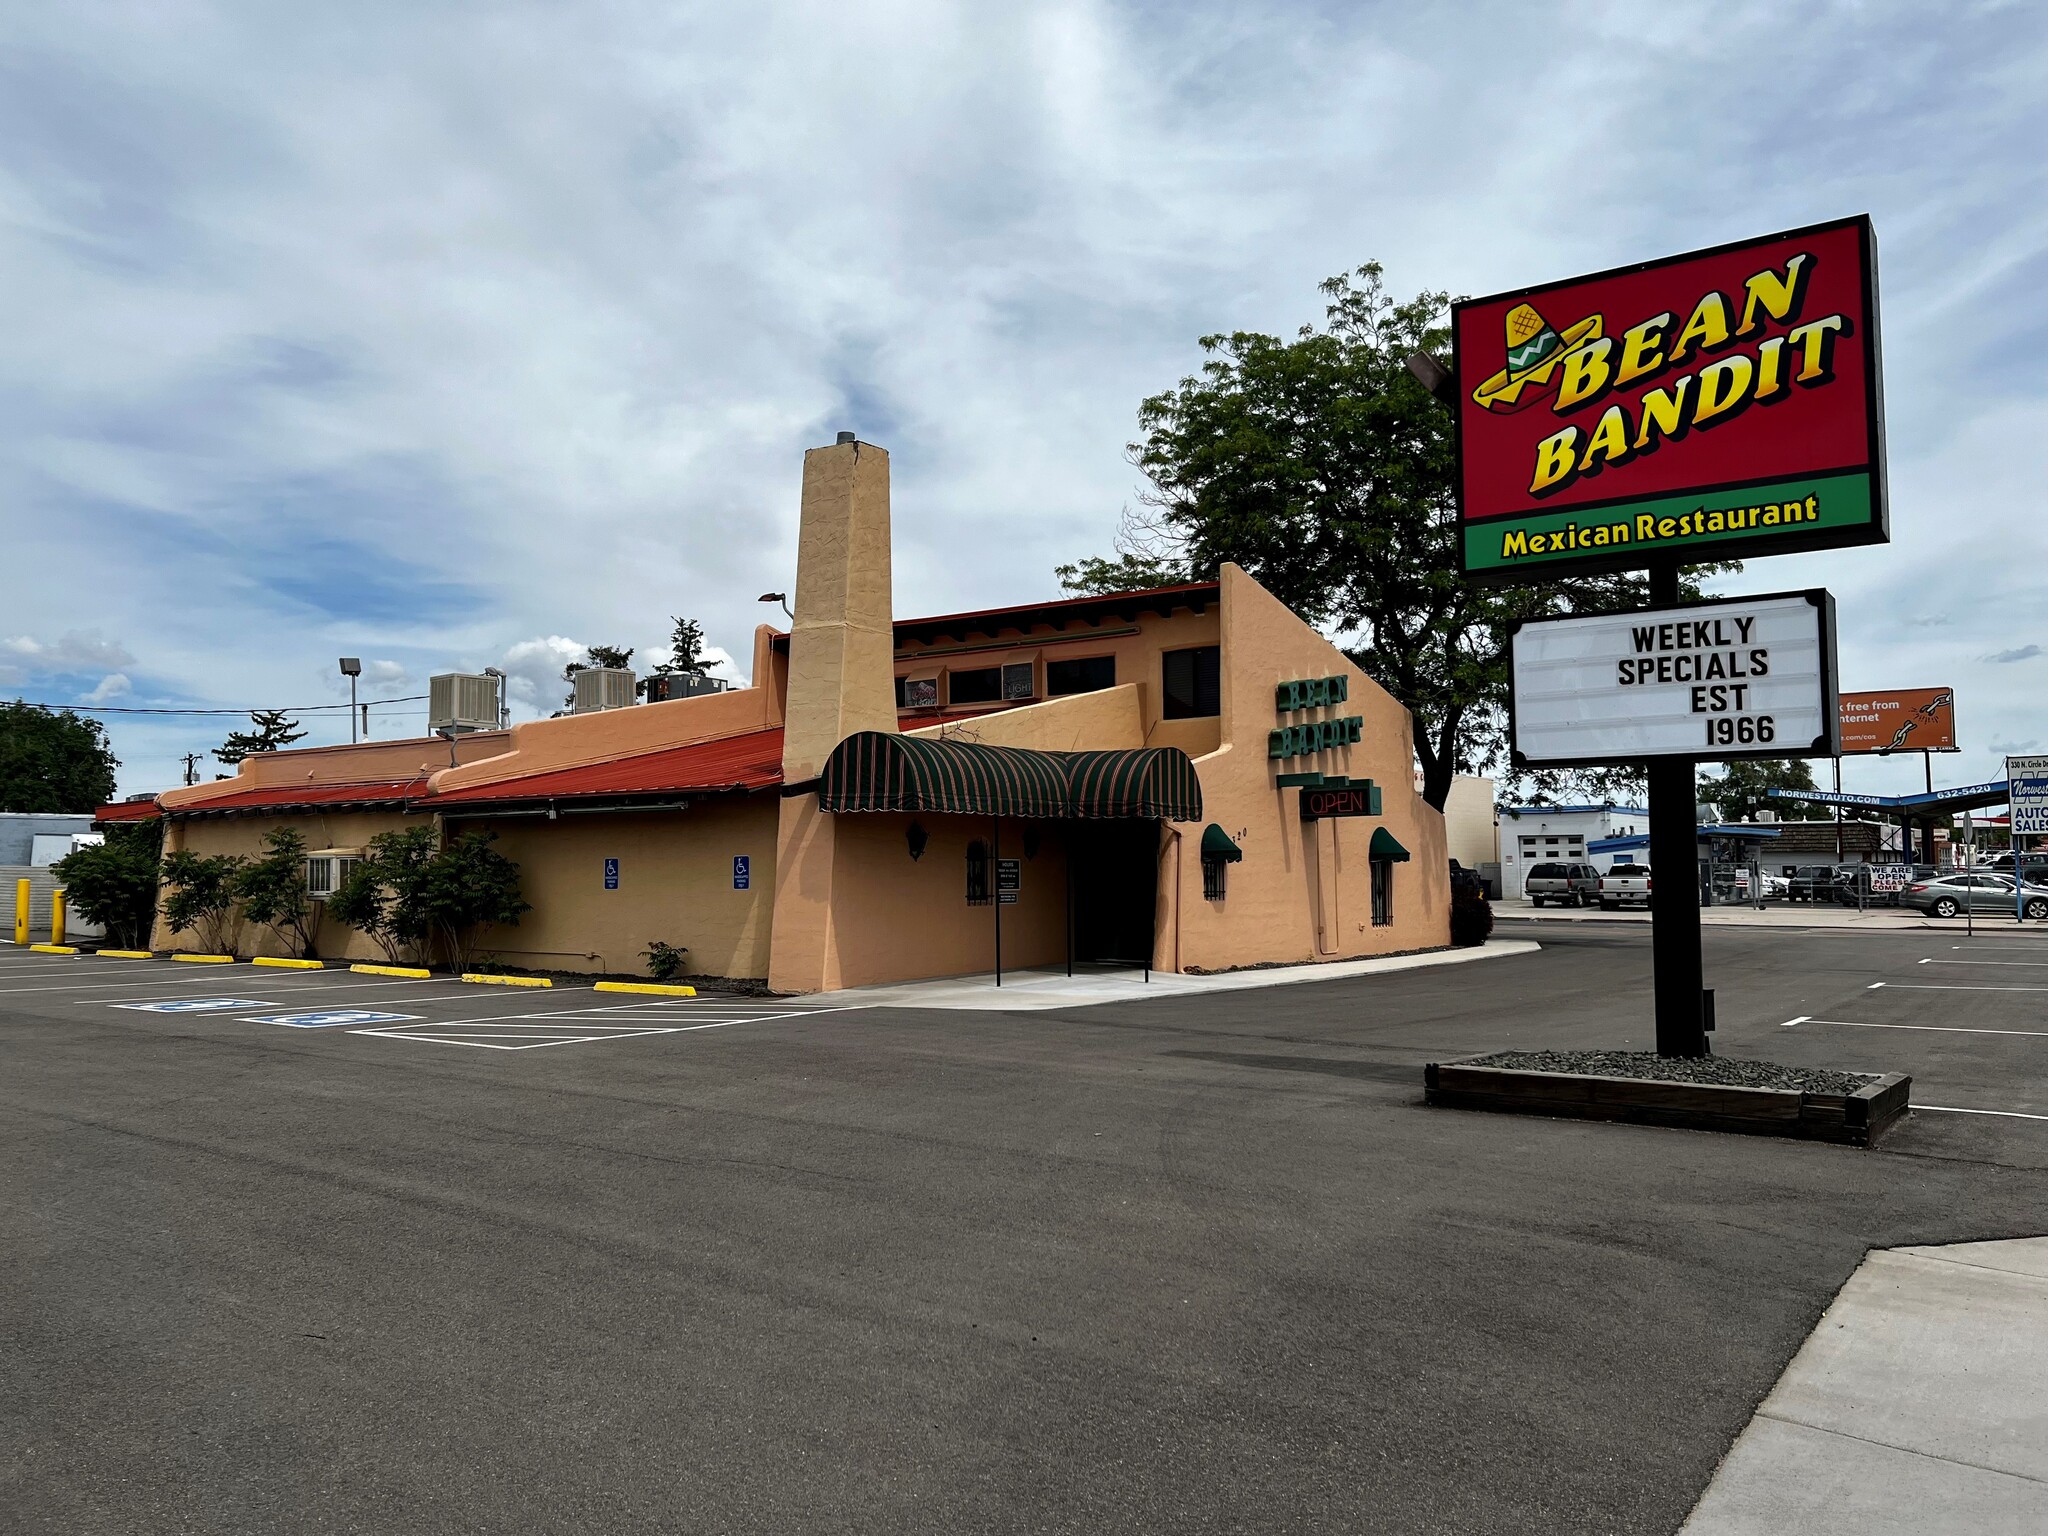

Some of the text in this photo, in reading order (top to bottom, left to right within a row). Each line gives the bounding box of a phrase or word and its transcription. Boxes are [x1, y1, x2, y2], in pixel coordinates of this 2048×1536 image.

[1553, 253, 1809, 412] BEAN
[1529, 314, 1843, 493] BANDIT
[1503, 496, 1817, 557] Mexican Restaurant
[1632, 616, 1755, 652] WEEKLY
[1618, 648, 1769, 685] SPECIALS
[1008, 682, 1032, 693] LIGHT
[1285, 675, 1348, 711] BEAN
[1691, 683, 1748, 713] EST
[1839, 713, 1880, 723] nternet
[1846, 701, 1869, 711] free
[1872, 700, 1900, 710] from
[1277, 716, 1363, 759] BANDIT
[1707, 715, 1775, 746] 1966
[2011, 761, 2020, 769] 330
[2028, 759, 2040, 768] Circle
[1310, 791, 1363, 814] OPEN
[1778, 789, 1880, 804] NORWESTAUTO.COM
[1936, 785, 1991, 800] 632-5420
